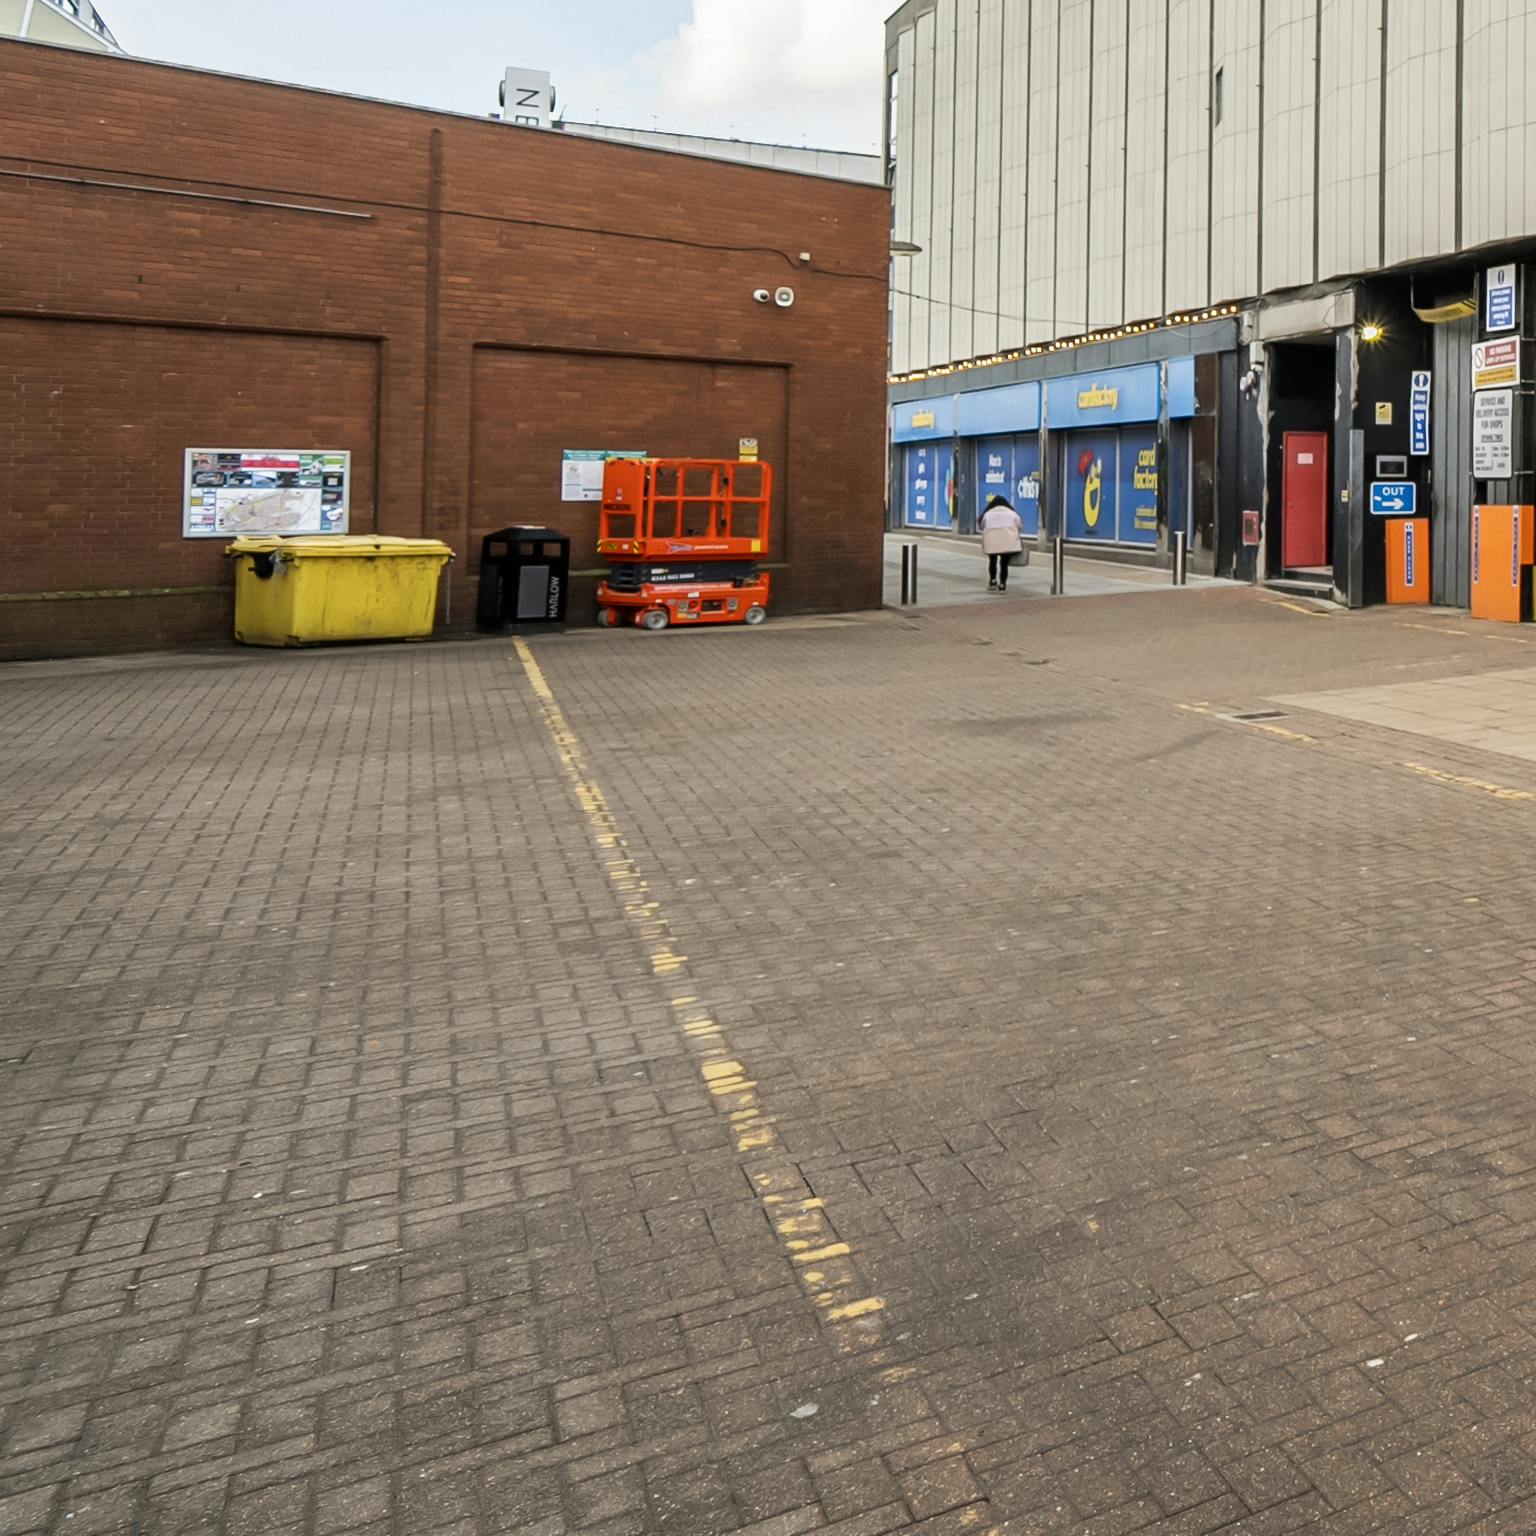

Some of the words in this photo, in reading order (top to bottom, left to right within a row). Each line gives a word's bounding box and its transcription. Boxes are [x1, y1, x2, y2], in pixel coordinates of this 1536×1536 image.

[1138, 442, 1156, 466] card
[1382, 486, 1406, 496] OUT
[549, 576, 560, 618] HARLOW
